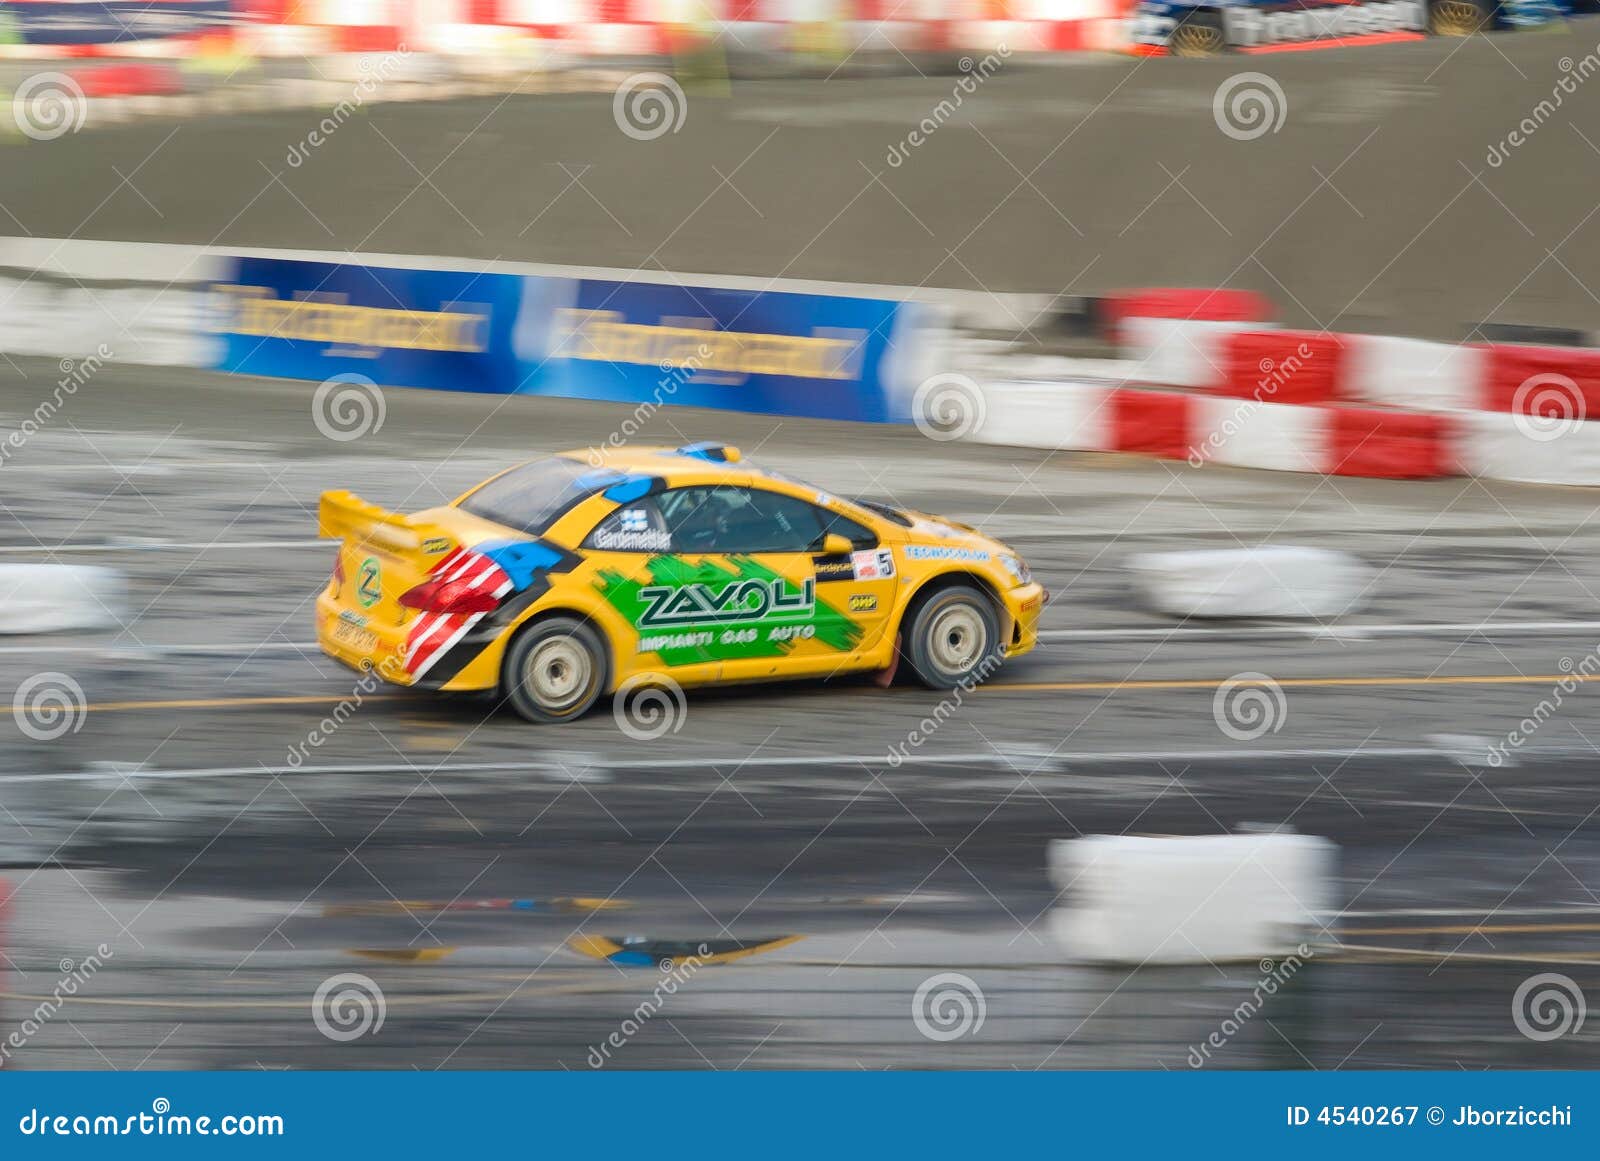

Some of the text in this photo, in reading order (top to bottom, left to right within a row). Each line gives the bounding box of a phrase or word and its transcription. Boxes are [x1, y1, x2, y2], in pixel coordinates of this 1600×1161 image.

[877, 551, 894, 575] 5
[636, 576, 817, 630] ZAVOLI
[638, 623, 816, 654] IMPIANTI GAS AUTO
